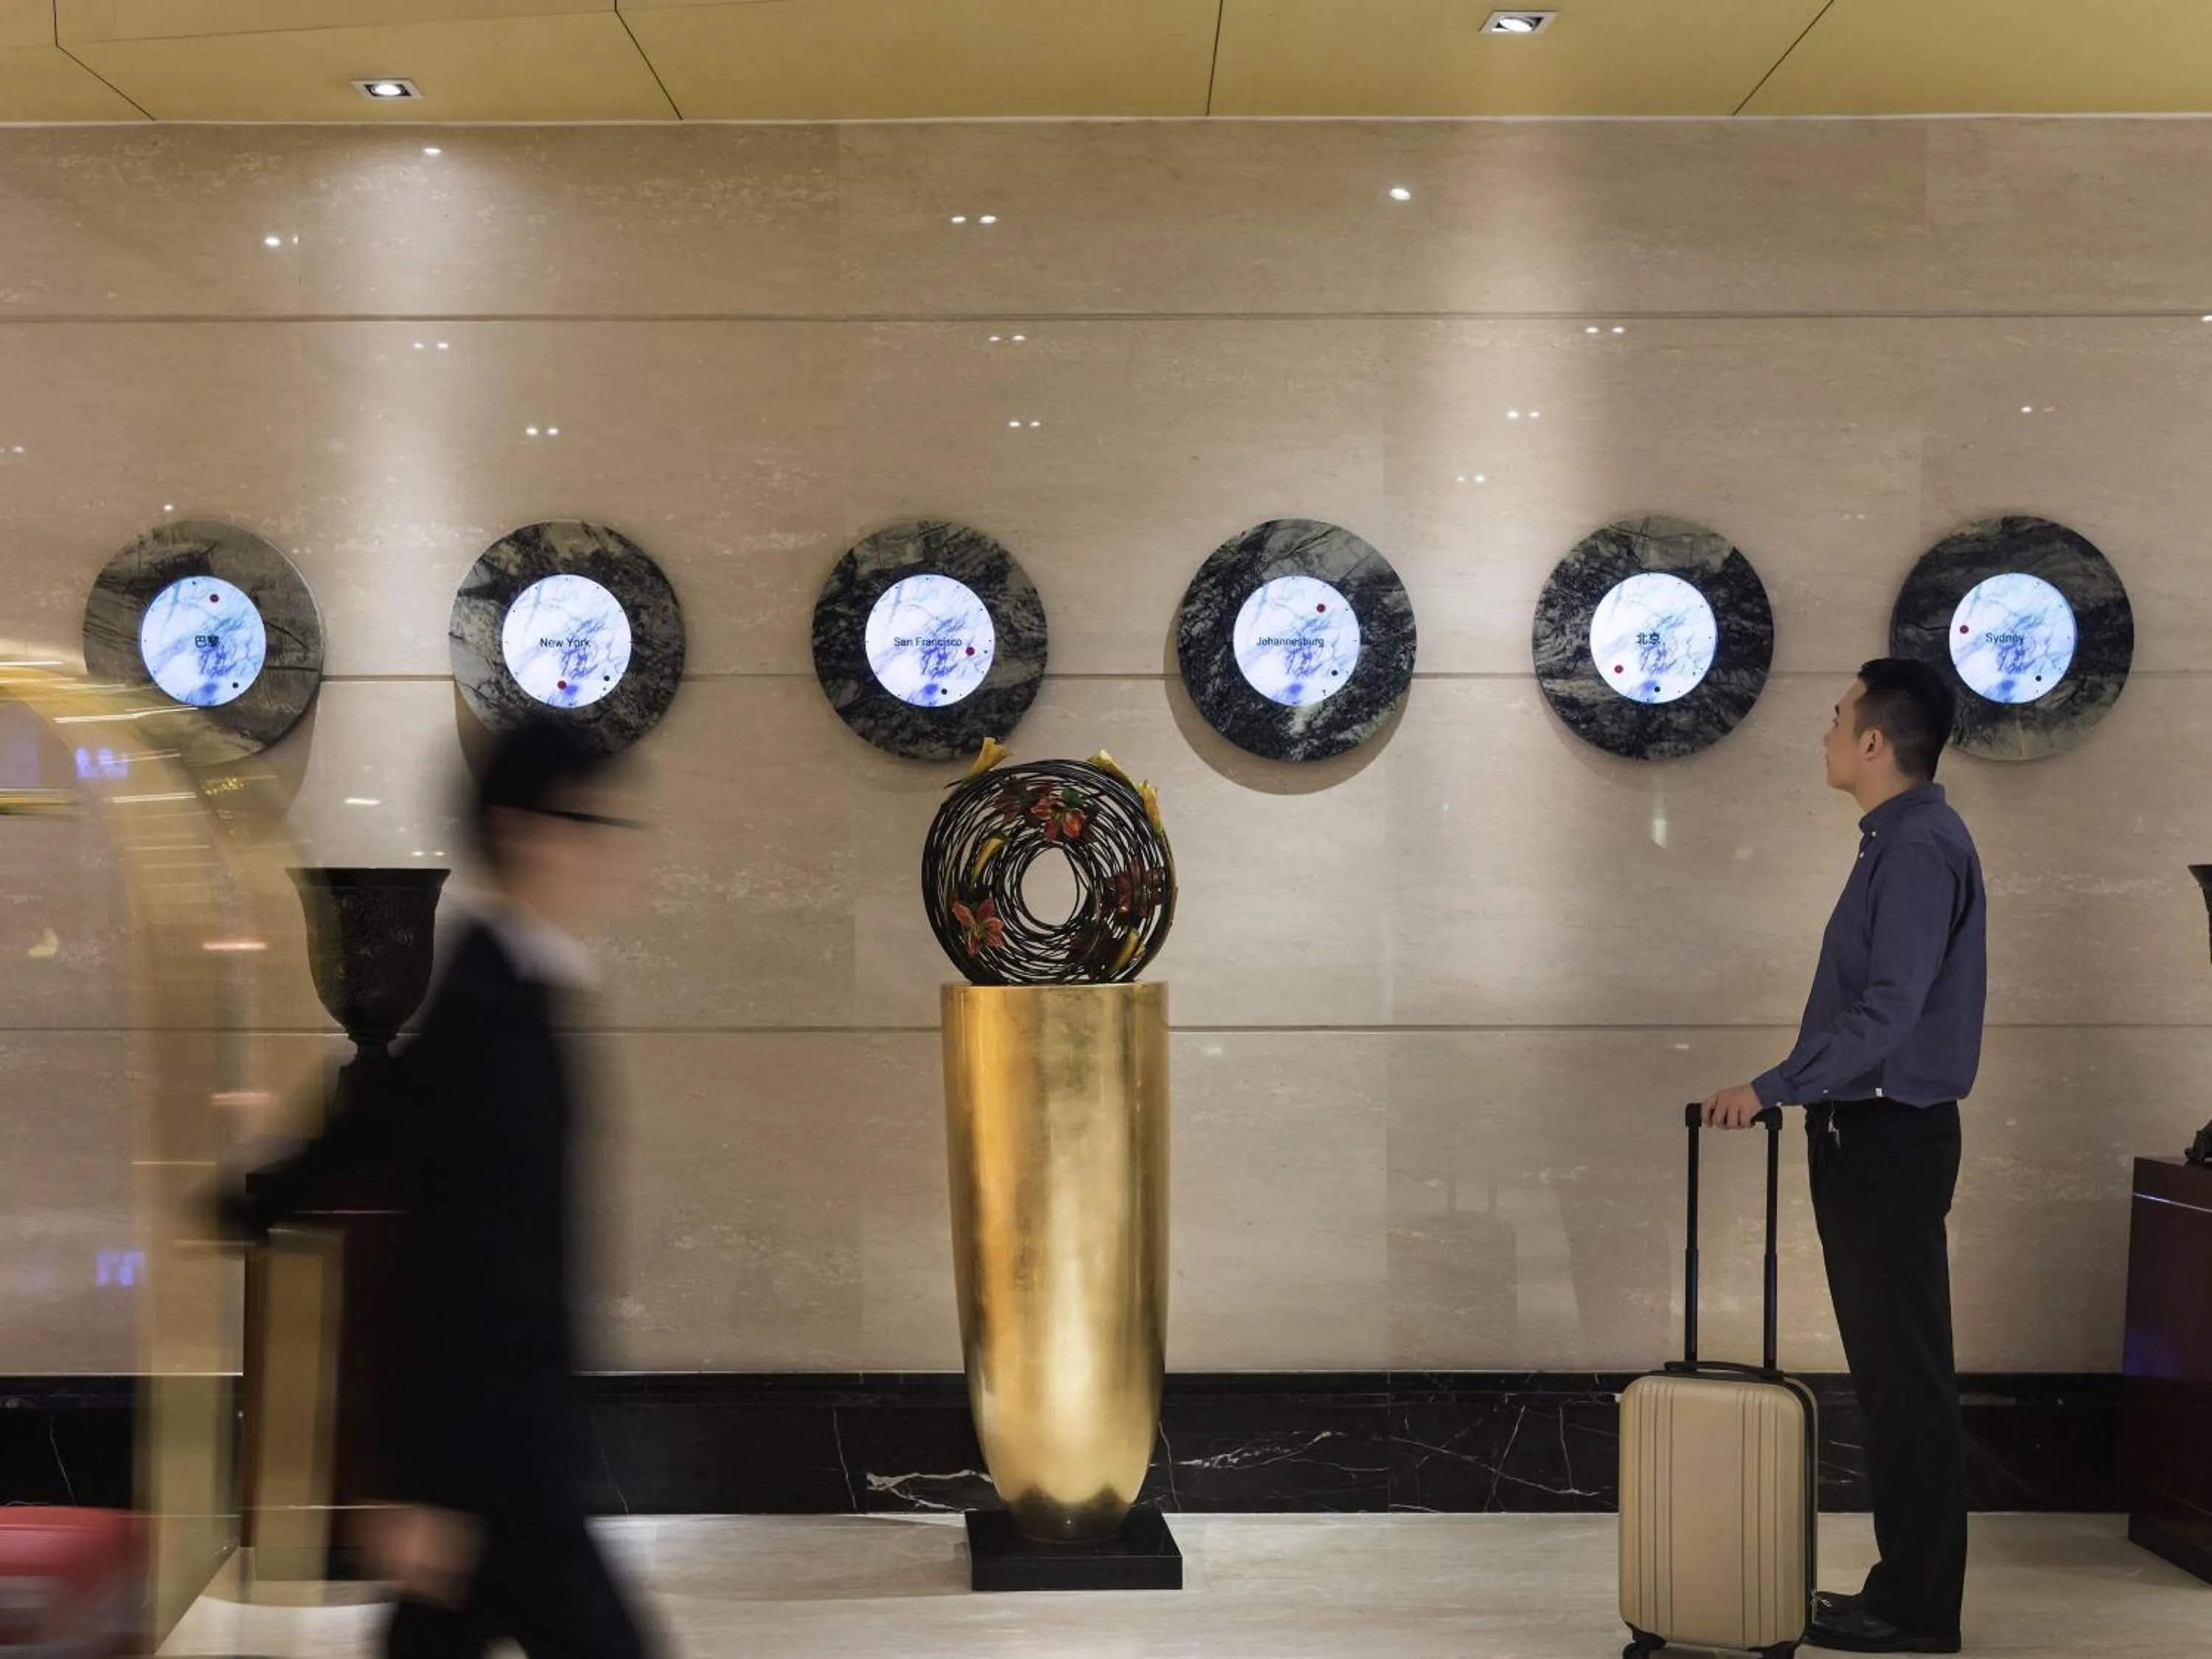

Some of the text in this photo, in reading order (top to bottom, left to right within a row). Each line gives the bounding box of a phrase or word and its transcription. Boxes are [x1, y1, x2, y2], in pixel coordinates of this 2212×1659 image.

[540, 637, 591, 647] New York
[894, 637, 962, 647] San Francisco
[1256, 636, 1325, 649] Johannesburg
[1636, 633, 1660, 645] 北京
[1986, 632, 2024, 645] Sydney
